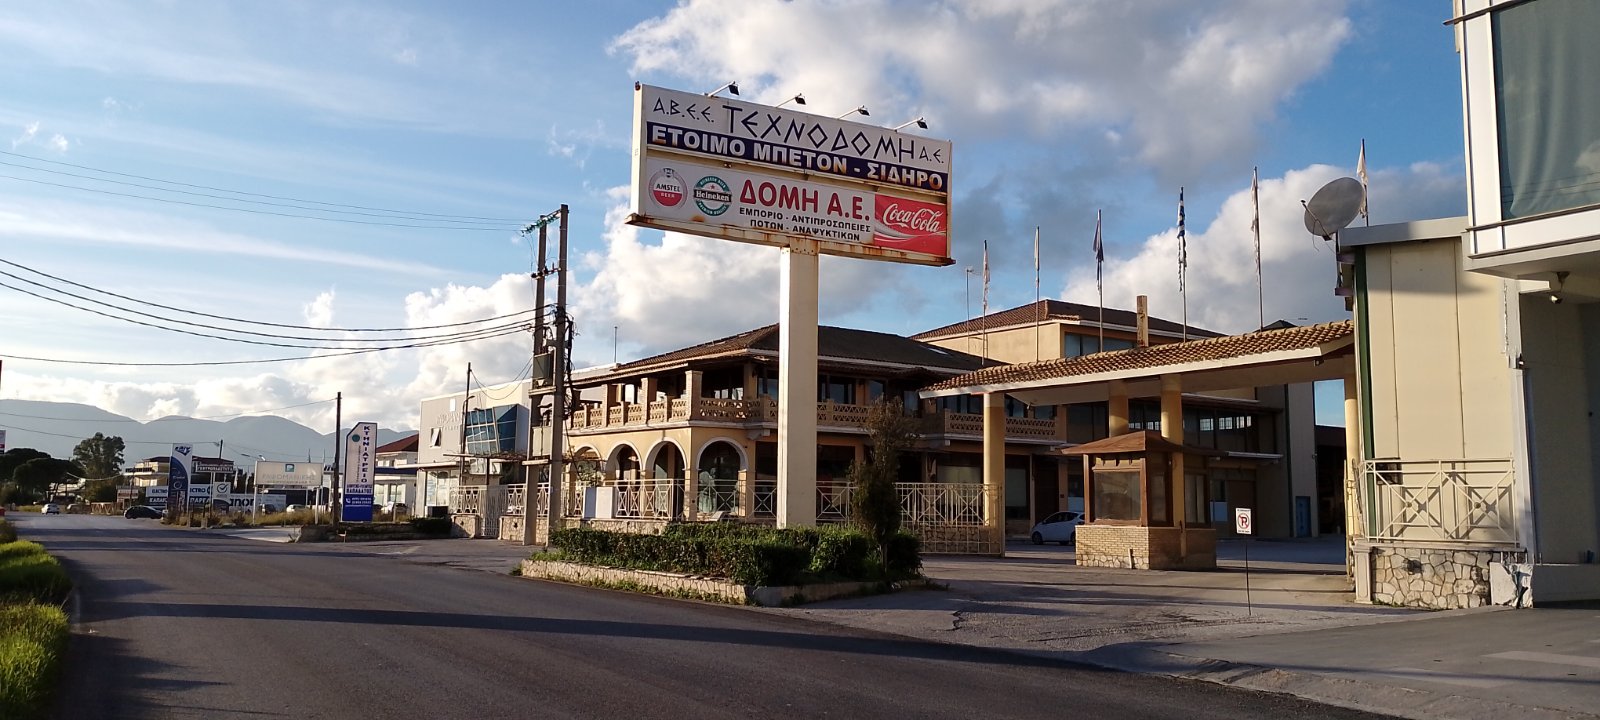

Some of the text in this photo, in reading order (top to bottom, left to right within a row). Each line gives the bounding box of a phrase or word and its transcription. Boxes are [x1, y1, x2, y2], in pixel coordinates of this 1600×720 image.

[722, 105, 914, 162] ΤΕΧΝΟΔΟΜΗ
[919, 146, 944, 163] Α.Ε.
[652, 125, 746, 156] ΕΤΟΙΜΟ
[753, 142, 847, 175] ΜΠΕΤΟΝ
[867, 162, 943, 190] ΣΙΔΗΡΟ
[656, 183, 680, 192] AMSTEL
[696, 190, 729, 202] Heineken
[739, 179, 870, 221] ΔΟΜΗ Α.Ε.
[739, 207, 783, 220] ΕΜΠΟΡΙΟ
[791, 215, 871, 232] ΑΝΤΙΠΡΟΣΩΠΕΙΕΣ
[750, 219, 784, 230] ΠΟΤΩΝ
[792, 225, 860, 241] ΑΝΑΨΥΚΤΙΚΩΝ
[361, 425, 370, 483] ΚΤΗΝΙΑΤΡΕΙΟ
